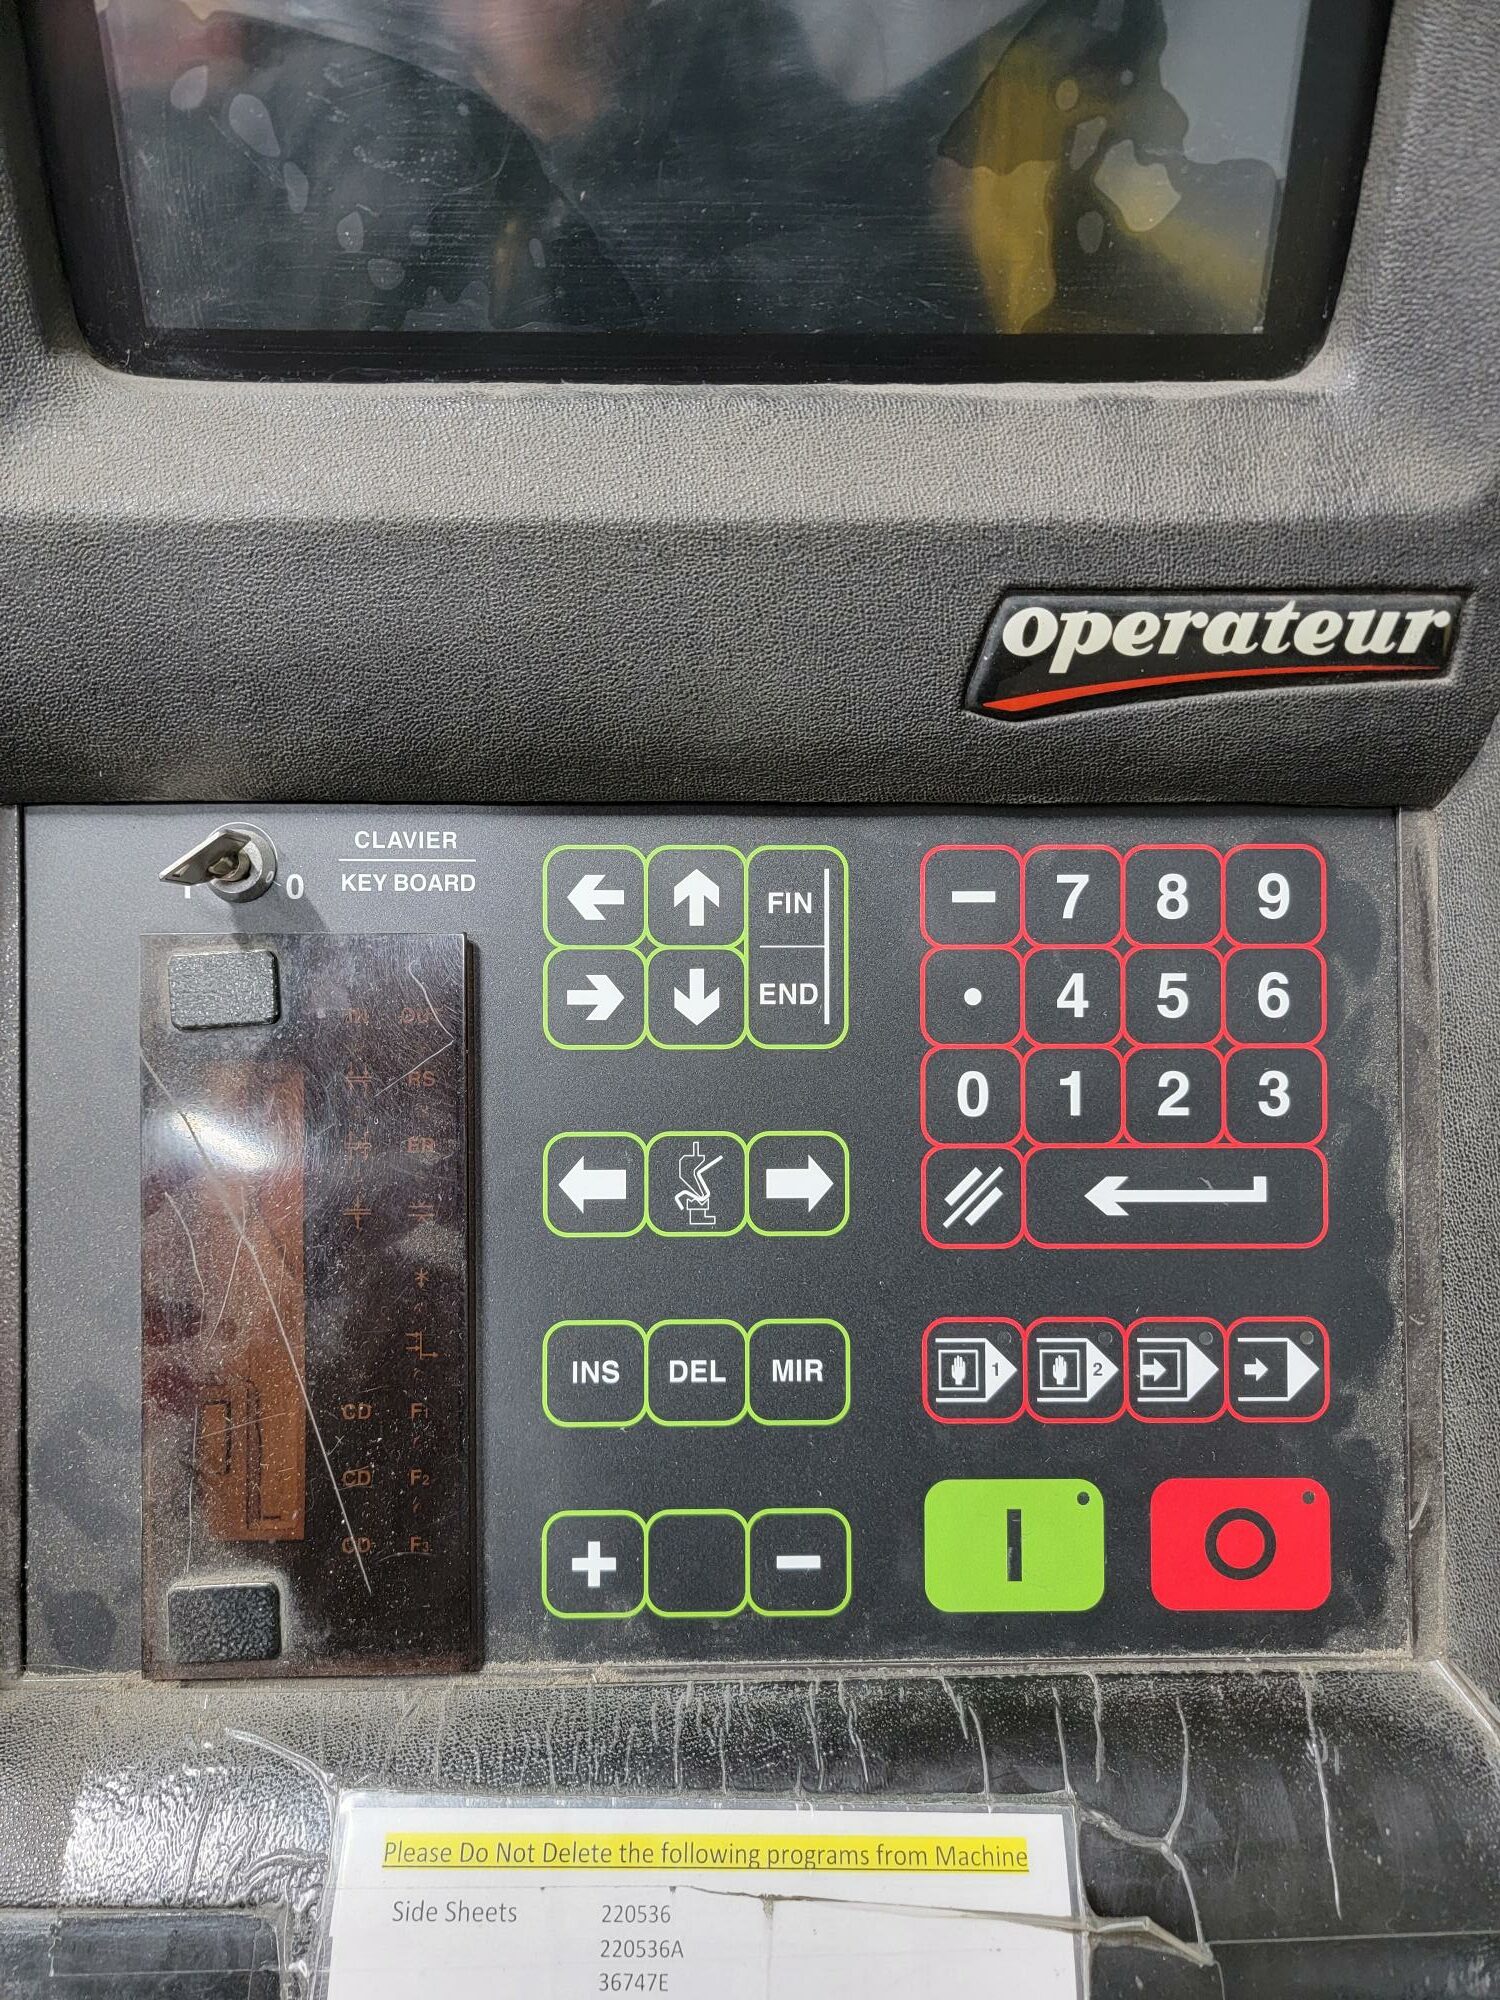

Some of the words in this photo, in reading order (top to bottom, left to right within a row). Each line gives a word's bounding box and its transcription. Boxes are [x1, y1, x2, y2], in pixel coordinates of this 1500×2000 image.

[354, 830, 457, 850] CLAVIER
[768, 891, 813, 914] FIN
[1056, 874, 1090, 919] 7
[1156, 873, 1189, 920] 8
[1257, 872, 1290, 920] 9
[759, 982, 819, 1006] END
[1056, 972, 1090, 1018] 4
[1156, 972, 1189, 1019] 5
[1257, 971, 1290, 1019] 6
[956, 1070, 989, 1118] 0
[1059, 1070, 1082, 1117] 1
[1157, 1070, 1190, 1116] 2
[1258, 1070, 1291, 1117] 3
[572, 1360, 620, 1384] INS
[669, 1359, 727, 1383] DEL
[772, 1358, 824, 1383] MIR
[1093, 1362, 1103, 1377] 2
[384, 1840, 452, 1863] Please
[460, 1842, 489, 1863] Do
[496, 1842, 535, 1863] Not
[543, 1841, 613, 1863] Delete
[619, 1841, 655, 1864] the
[661, 1842, 761, 1869] following
[768, 1848, 870, 1869] programs
[876, 1843, 928, 1866] from
[936, 1844, 1028, 1868] Machine
[392, 1900, 438, 1922] Side
[444, 1899, 518, 1923] Sheets
[601, 1904, 672, 1924] 220536
[600, 1939, 684, 1959] 220536A
[598, 1972, 669, 1992] 36747E
